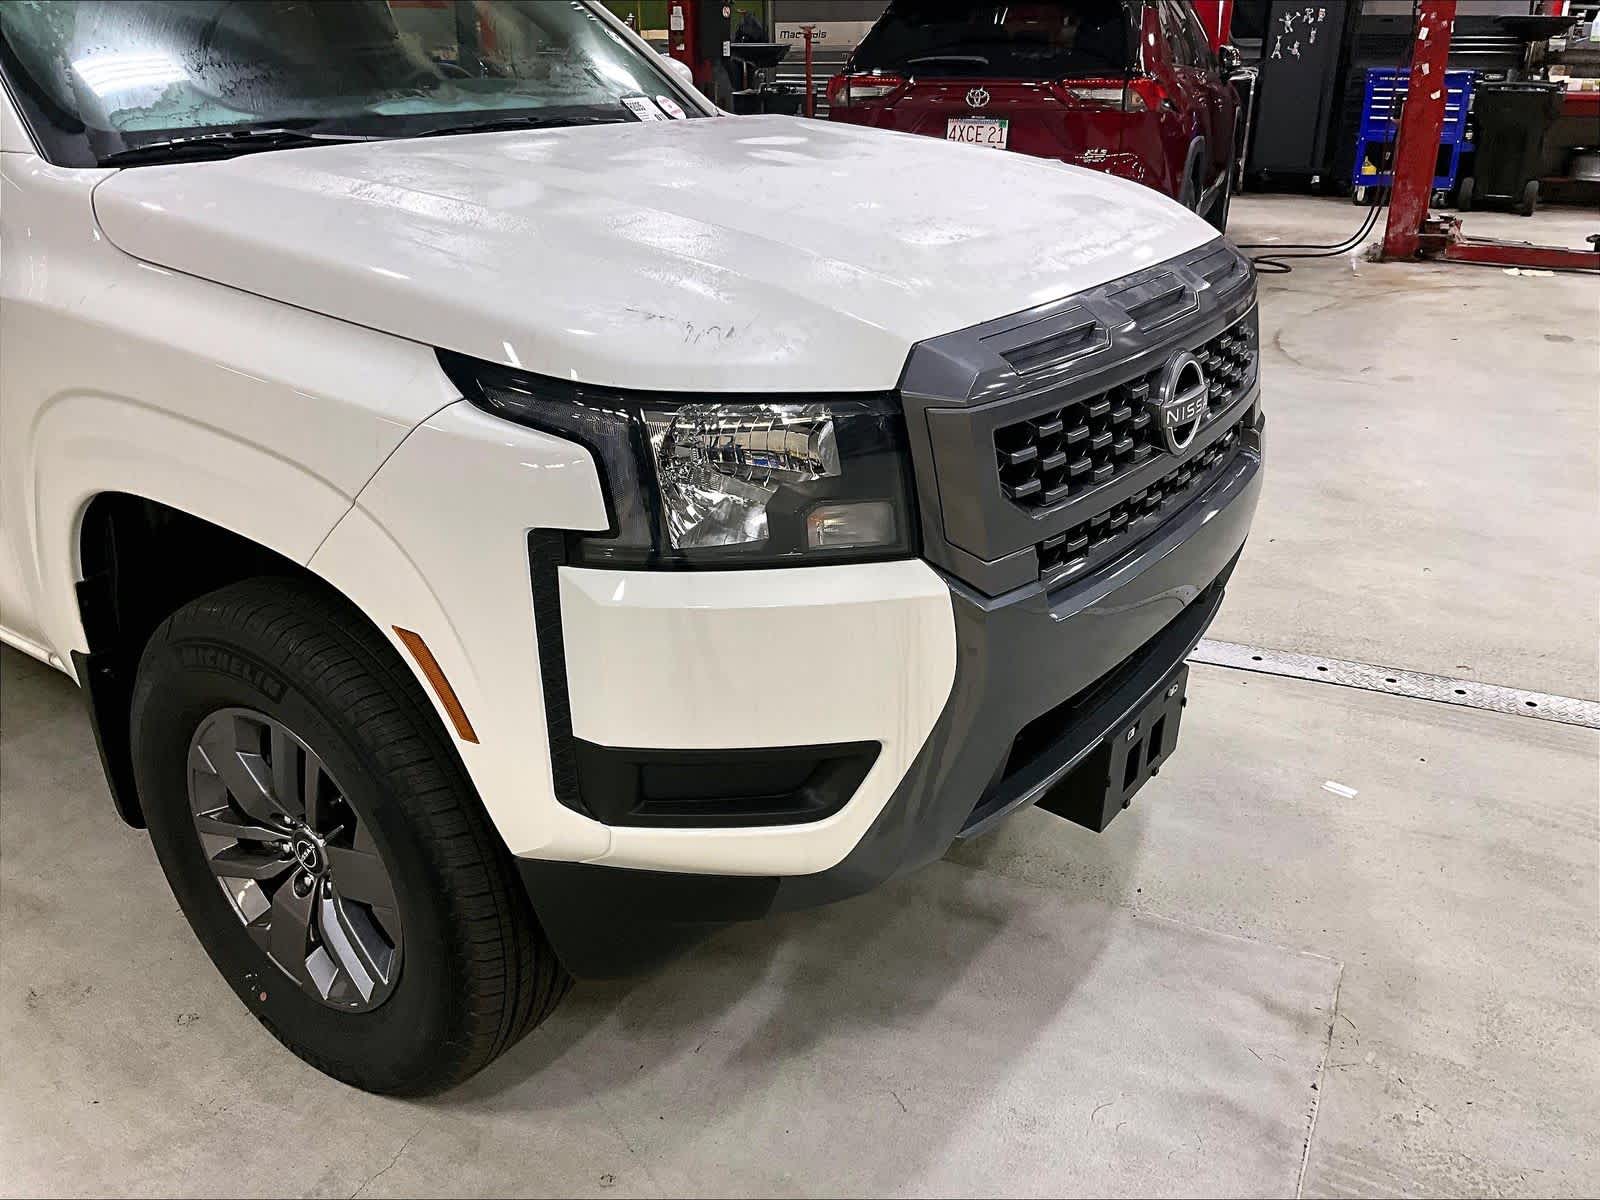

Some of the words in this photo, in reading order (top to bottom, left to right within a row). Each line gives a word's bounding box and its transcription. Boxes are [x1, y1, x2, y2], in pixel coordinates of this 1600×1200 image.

[780, 31, 801, 39] Mac
[949, 125, 984, 142] 4XCE
[987, 126, 1004, 144] 21
[182, 647, 281, 698] MICHELIN
